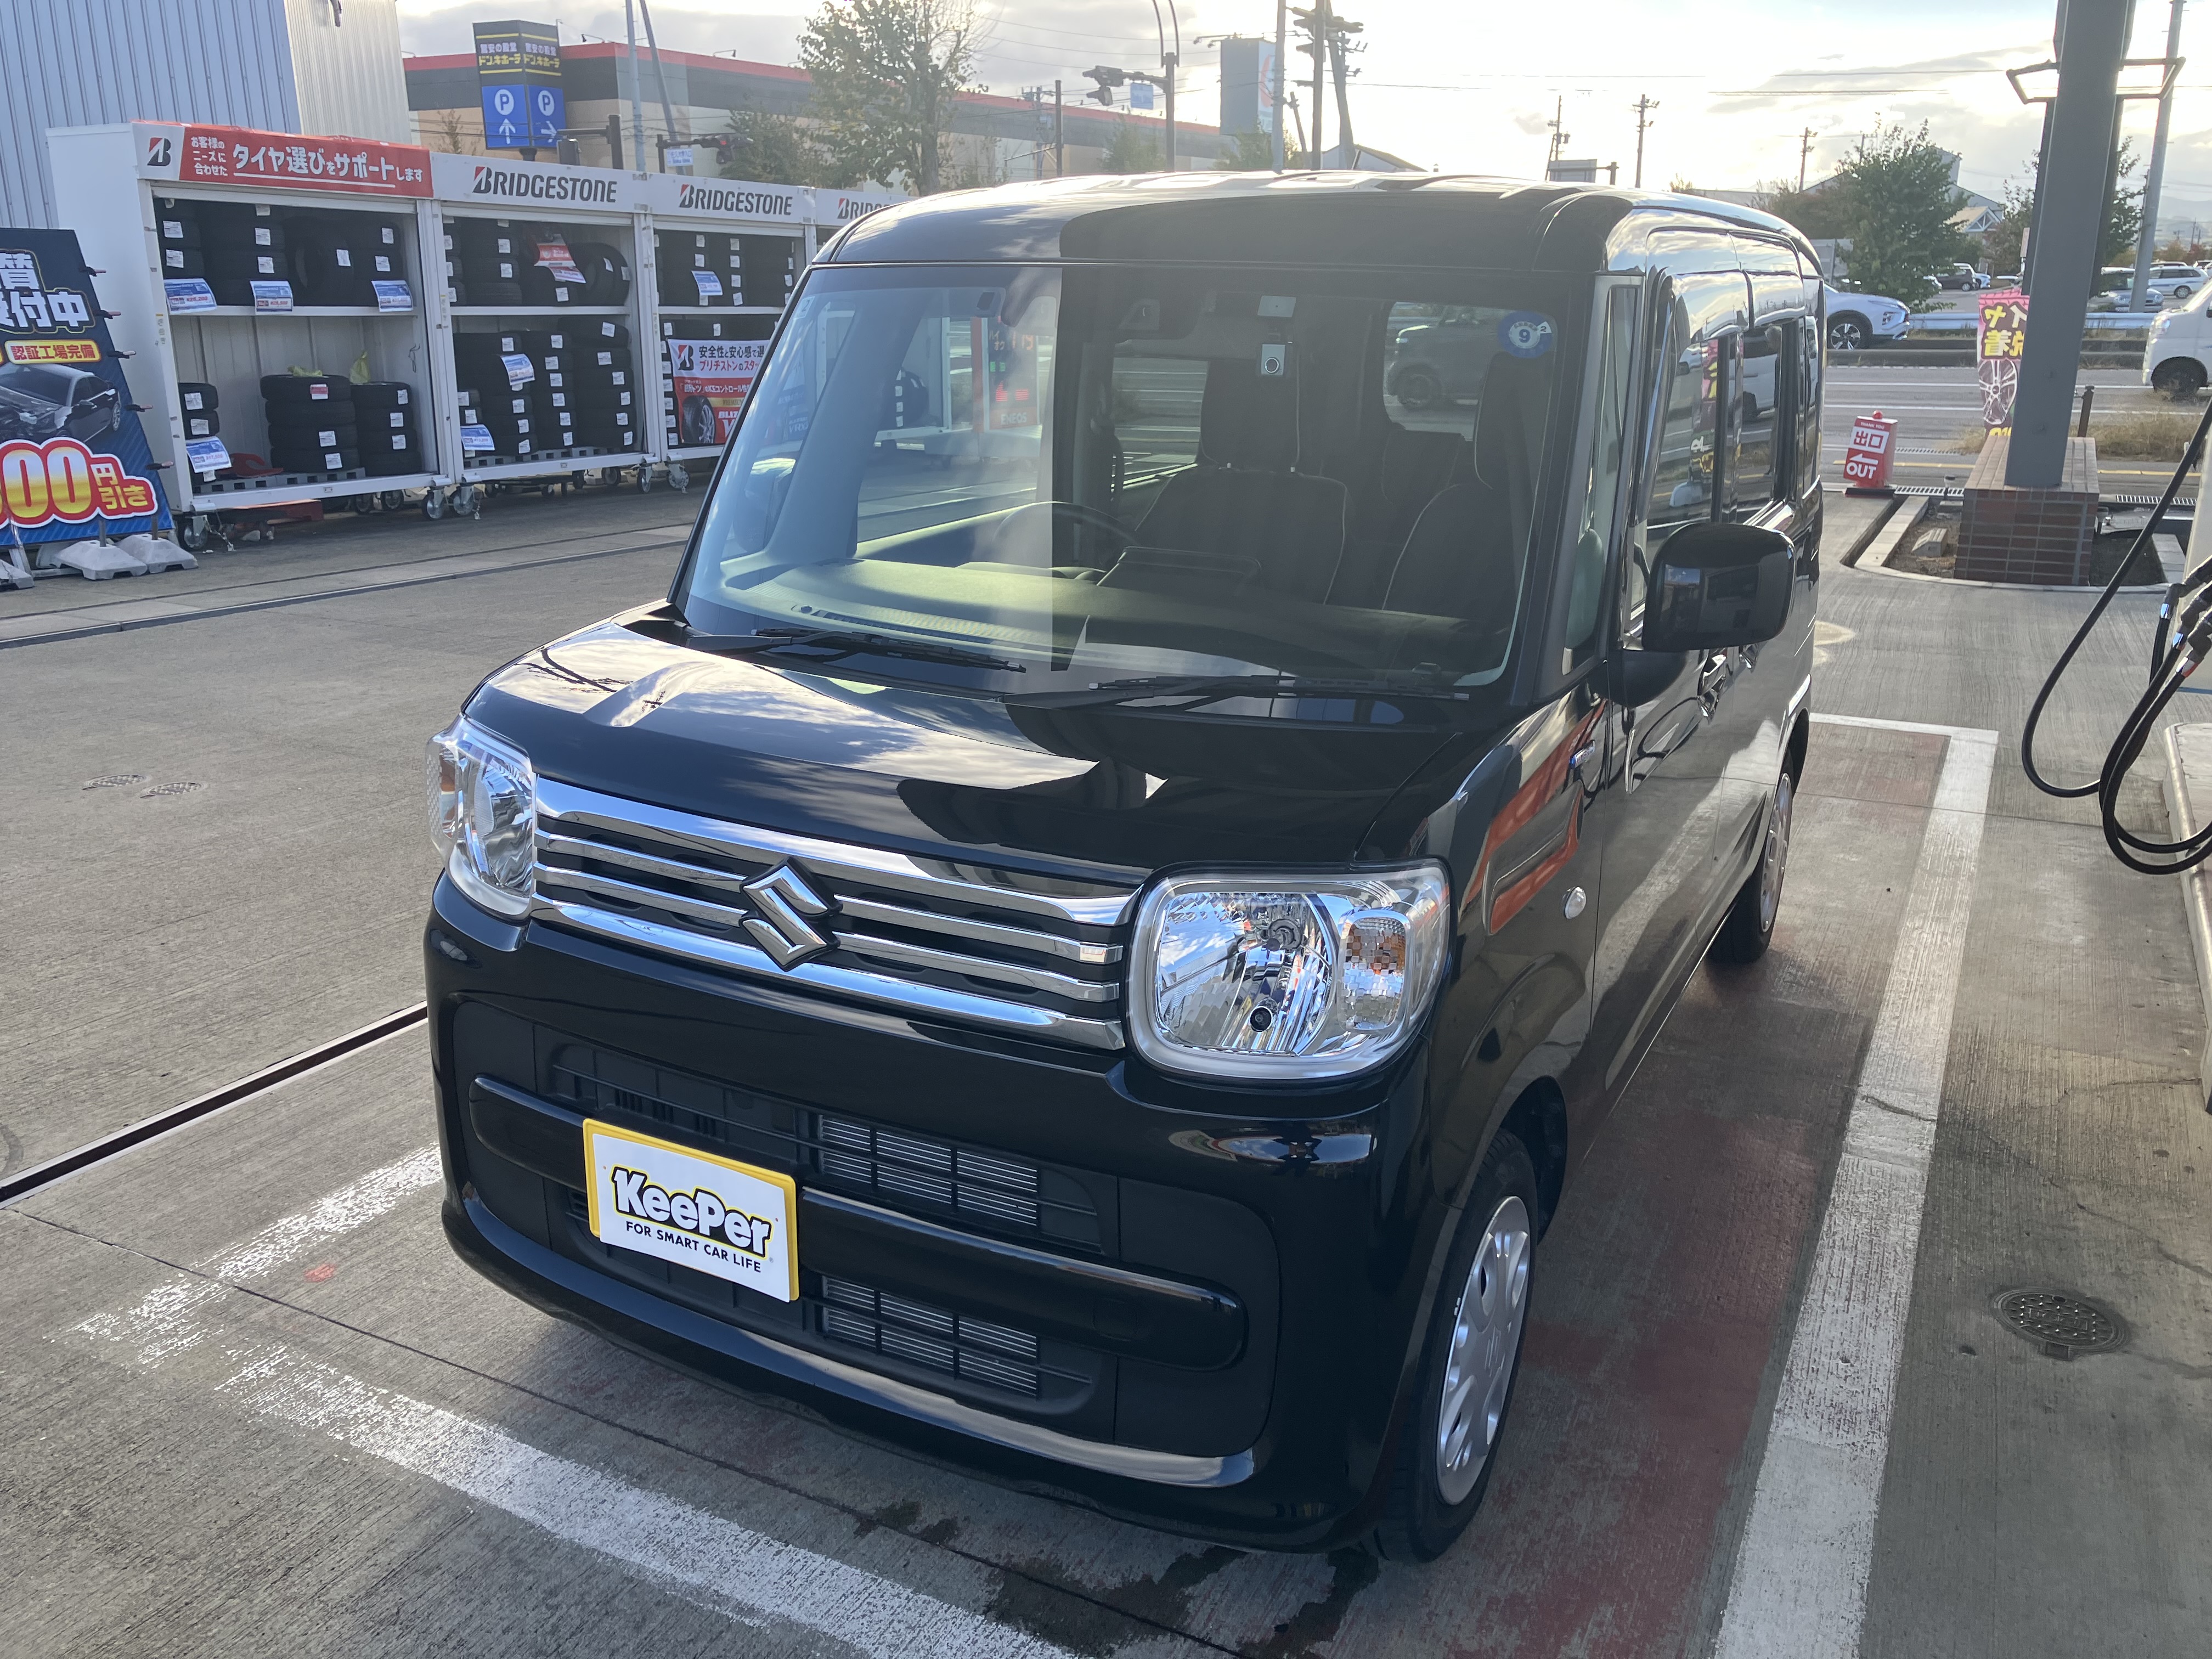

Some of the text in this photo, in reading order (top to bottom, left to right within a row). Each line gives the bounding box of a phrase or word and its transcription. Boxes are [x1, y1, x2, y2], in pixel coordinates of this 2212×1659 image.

[500, 94, 510, 111] P
[542, 94, 551, 111] P
[191, 137, 225, 149] お客様の
[193, 150, 226, 163] ニーズに
[233, 143, 423, 183] タイヤ選びをサポートします
[194, 162, 228, 177] 合わせた
[472, 166, 618, 203] BRIDGESTONE
[679, 184, 793, 216] BRIDGESTONE
[837, 198, 889, 219] BRID
[1519, 329, 1531, 343] 9
[10, 344, 96, 360] 認証工場完備
[1000, 412, 1028, 426] ENEOS
[1853, 431, 1884, 449] 出口
[90, 463, 119, 486] 円
[1846, 462, 1877, 479] OUT
[98, 485, 148, 510] 引き
[611, 1166, 772, 1258] KeePer
[626, 1221, 761, 1273] FOR SMART CAR LIFE
